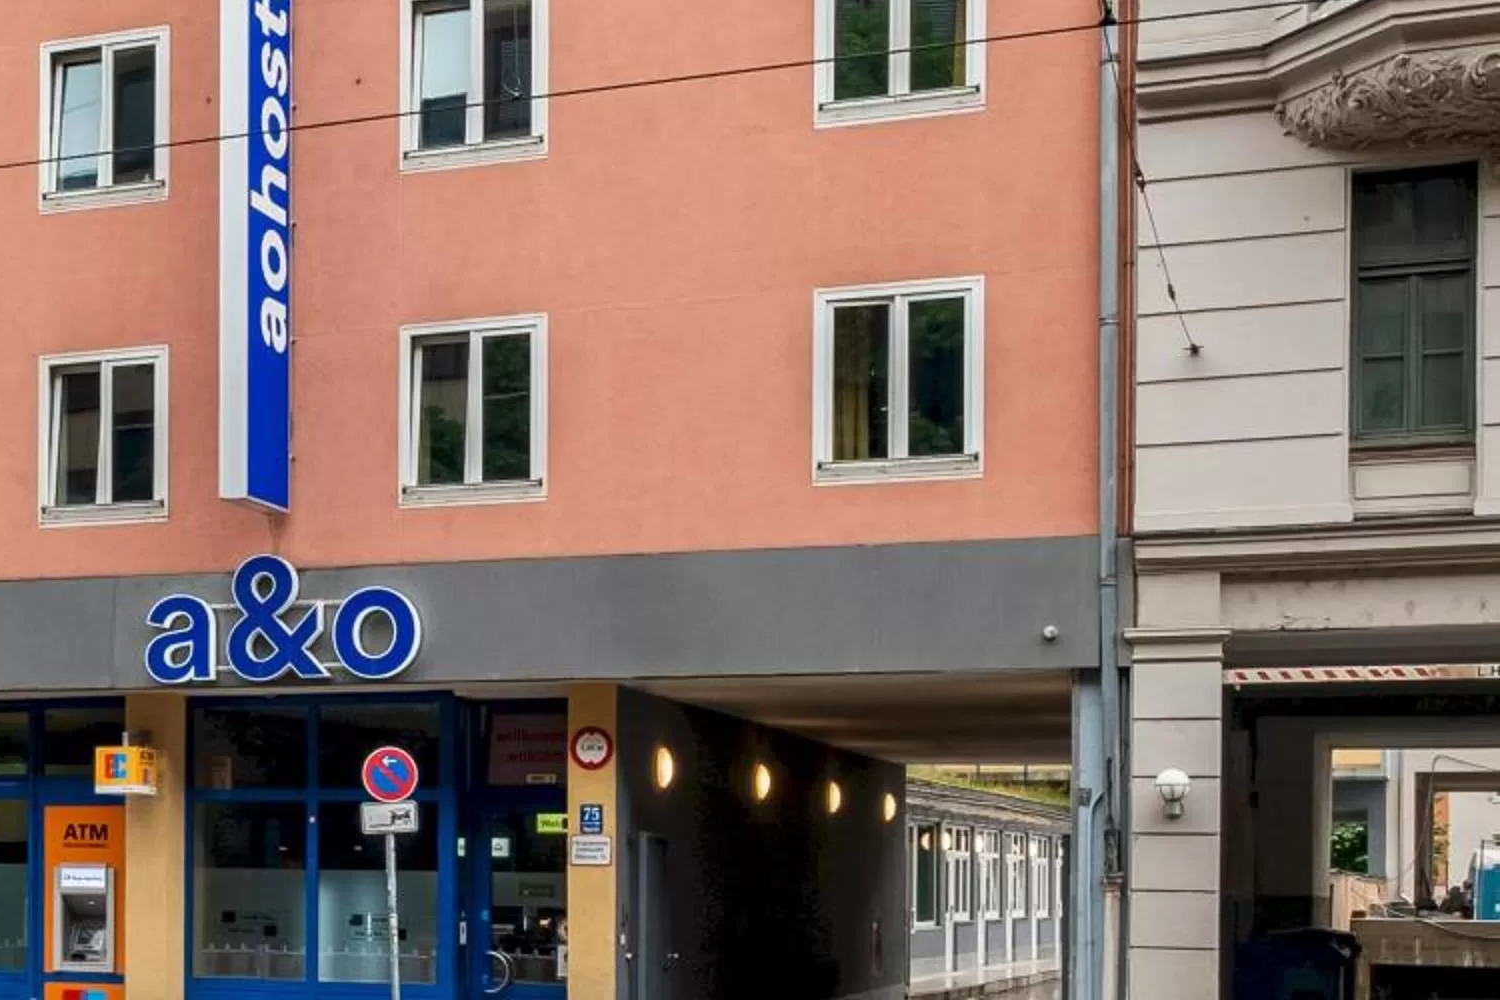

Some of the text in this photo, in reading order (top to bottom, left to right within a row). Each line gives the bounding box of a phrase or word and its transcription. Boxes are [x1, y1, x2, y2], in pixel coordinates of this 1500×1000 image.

[145, 554, 421, 684] a&o
[583, 807, 601, 821] 75
[63, 823, 109, 841] ATM
